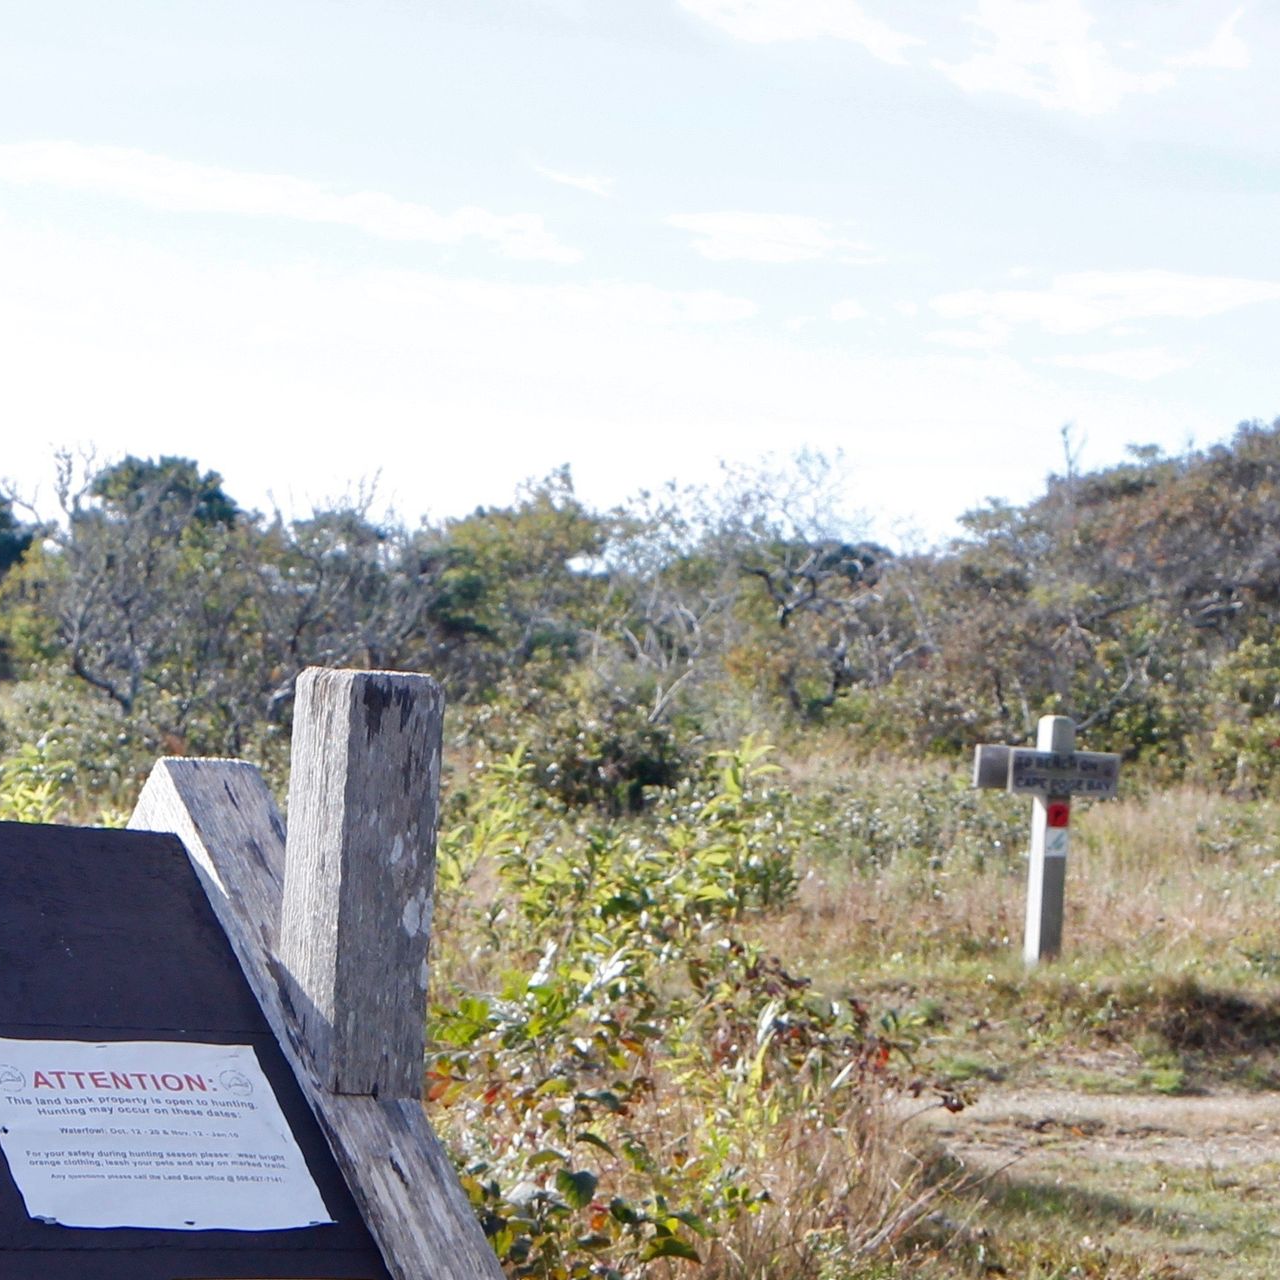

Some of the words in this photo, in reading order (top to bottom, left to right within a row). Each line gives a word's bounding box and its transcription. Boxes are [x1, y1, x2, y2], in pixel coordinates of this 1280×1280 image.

[1015, 776, 1048, 789] CAPE
[1086, 779, 1112, 792] BAY
[34, 1071, 217, 1091] ATTENTION:
[5, 1096, 32, 1105] This
[35, 1097, 61, 1105] land
[64, 1096, 94, 1105] bank
[98, 1096, 147, 1105] property
[151, 1097, 162, 1105] is
[165, 1098, 193, 1107] open
[196, 1098, 209, 1106] to
[211, 1099, 258, 1110] hunting.
[37, 1108, 86, 1116] Hunting
[89, 1107, 113, 1115] may
[171, 1108, 204, 1117] these
[207, 1109, 241, 1119] dates:
[44, 1150, 65, 1158] your
[68, 1150, 95, 1158] safety
[97, 1150, 127, 1158] during
[129, 1150, 164, 1158] hunting
[63, 1159, 104, 1167] clothing,
[231, 1160, 262, 1168] marked
